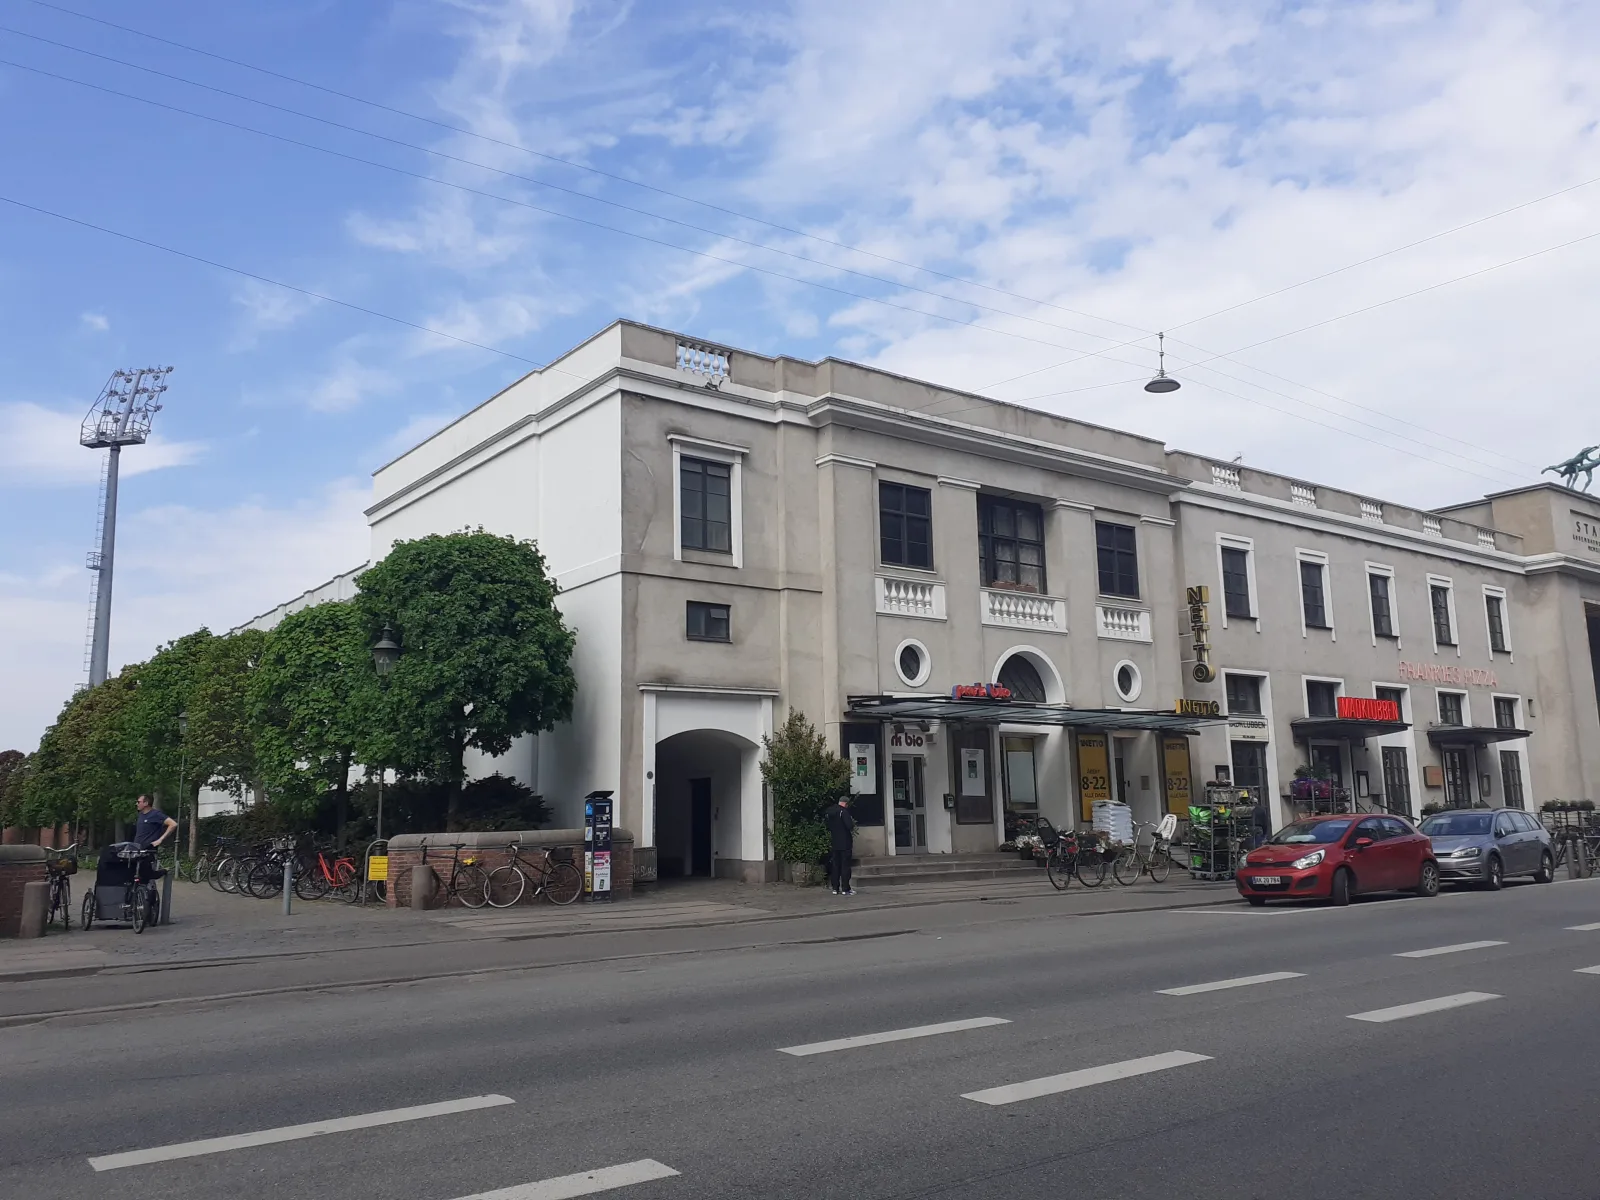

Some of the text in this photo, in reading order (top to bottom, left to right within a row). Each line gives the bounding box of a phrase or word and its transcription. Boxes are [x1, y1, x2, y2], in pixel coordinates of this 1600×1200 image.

[1576, 521, 1600, 537] STA
[1187, 585, 1216, 683] NETTO
[1399, 660, 1497, 688] FRANKIES PIZZA
[1176, 699, 1220, 715] NETTO
[1337, 697, 1398, 721] MADKLUBBEN
[905, 732, 924, 747] bio
[1082, 776, 1107, 790] 8-22
[1167, 777, 1188, 790] 8-22
